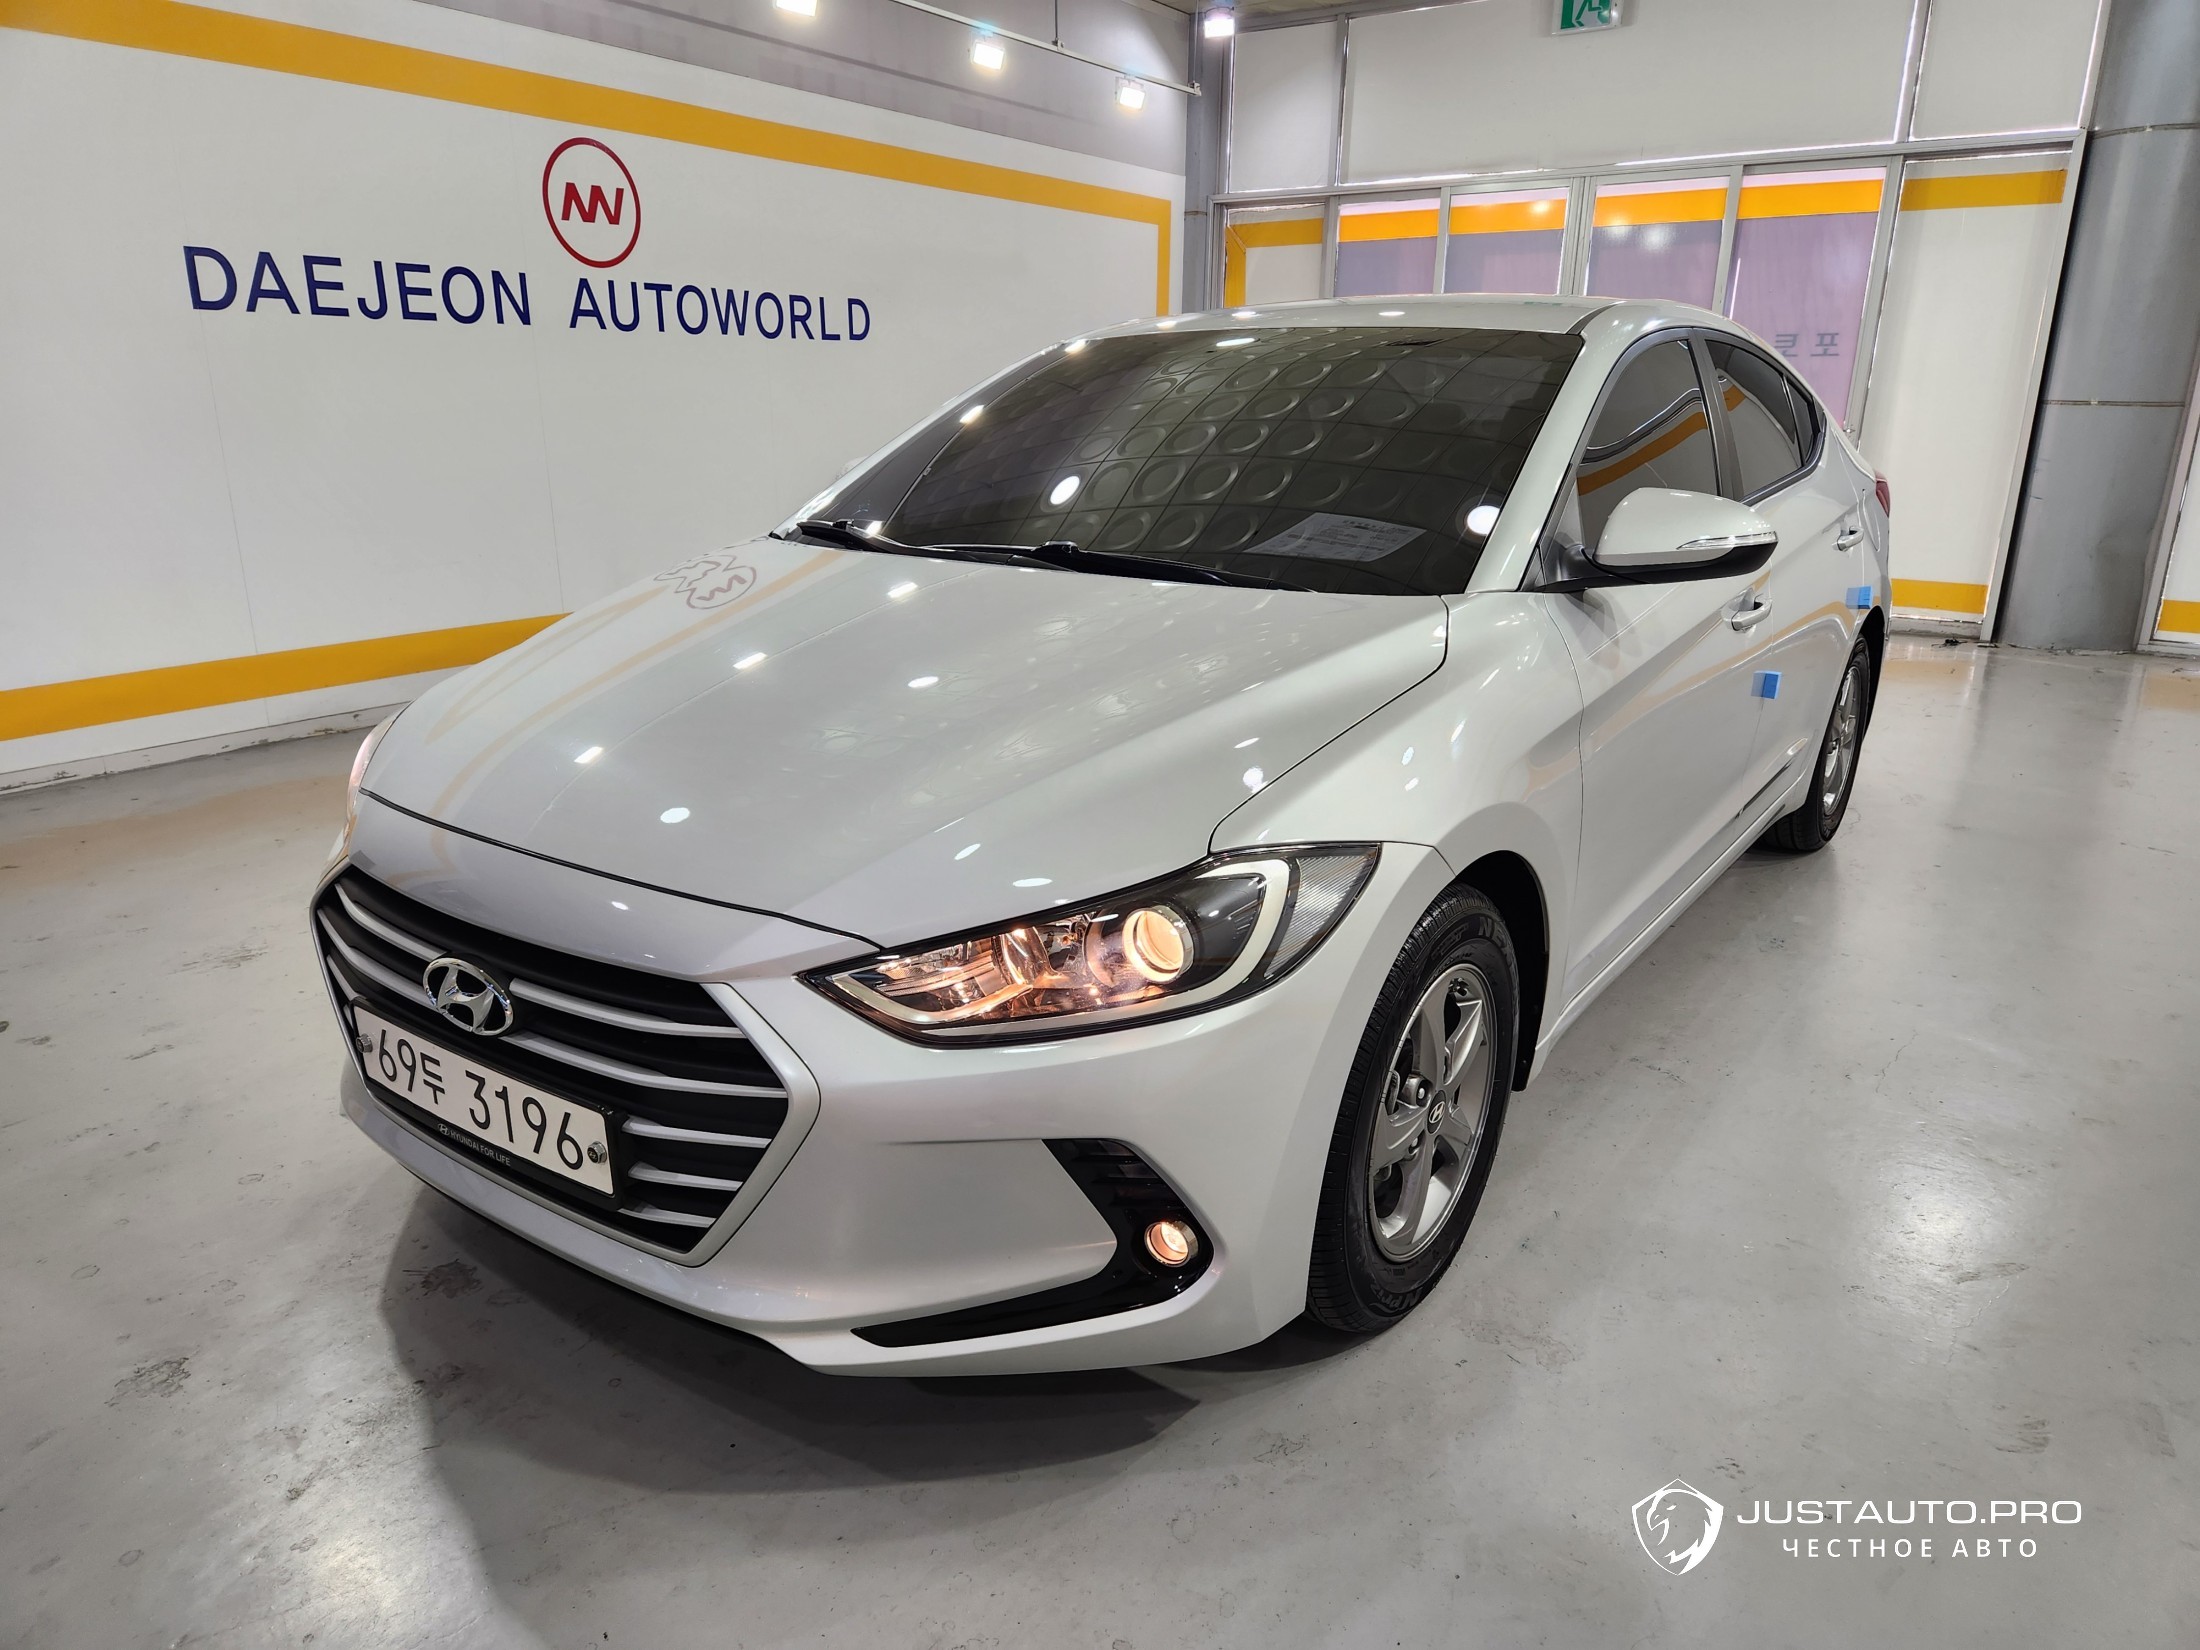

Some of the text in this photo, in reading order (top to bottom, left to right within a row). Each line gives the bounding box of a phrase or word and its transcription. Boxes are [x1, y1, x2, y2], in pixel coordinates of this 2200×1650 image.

[183, 245, 871, 341] DAEJEON AUTOWORLD
[378, 1029, 584, 1170] 69두 3196
[450, 1130, 511, 1166] HYUNDAI FOR LIFE
